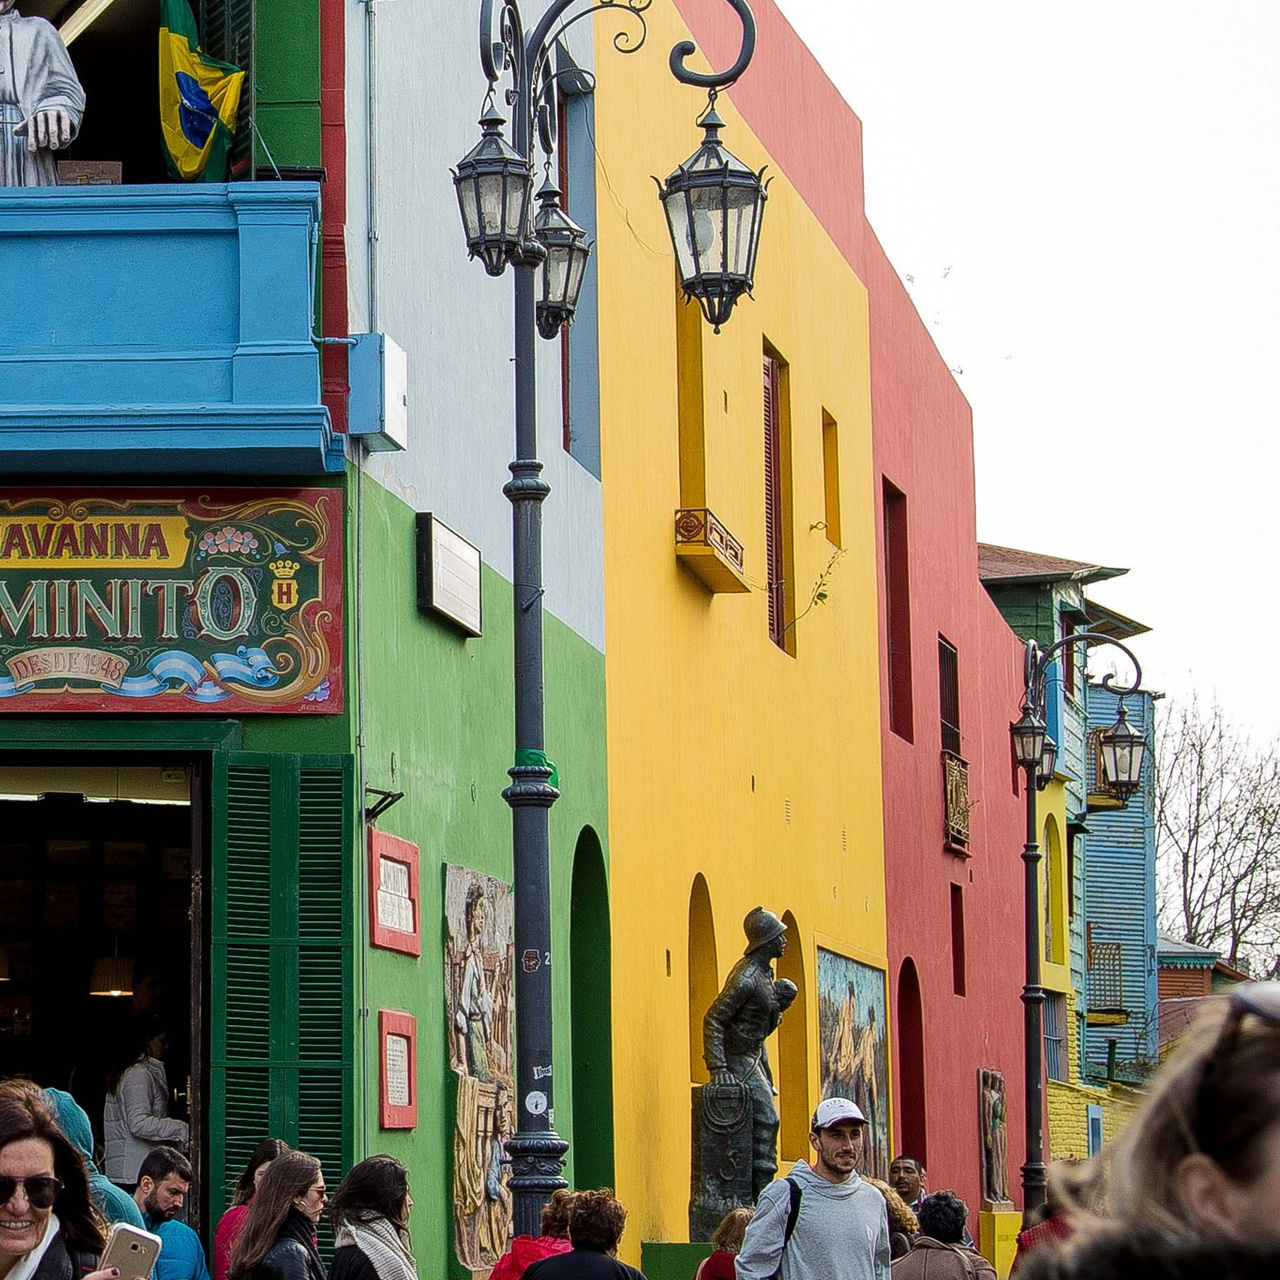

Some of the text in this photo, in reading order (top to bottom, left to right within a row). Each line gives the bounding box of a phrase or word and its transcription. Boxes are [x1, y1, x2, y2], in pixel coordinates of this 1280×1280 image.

[276, 582, 293, 605] H
[13, 651, 125, 681] DESDE 1948
